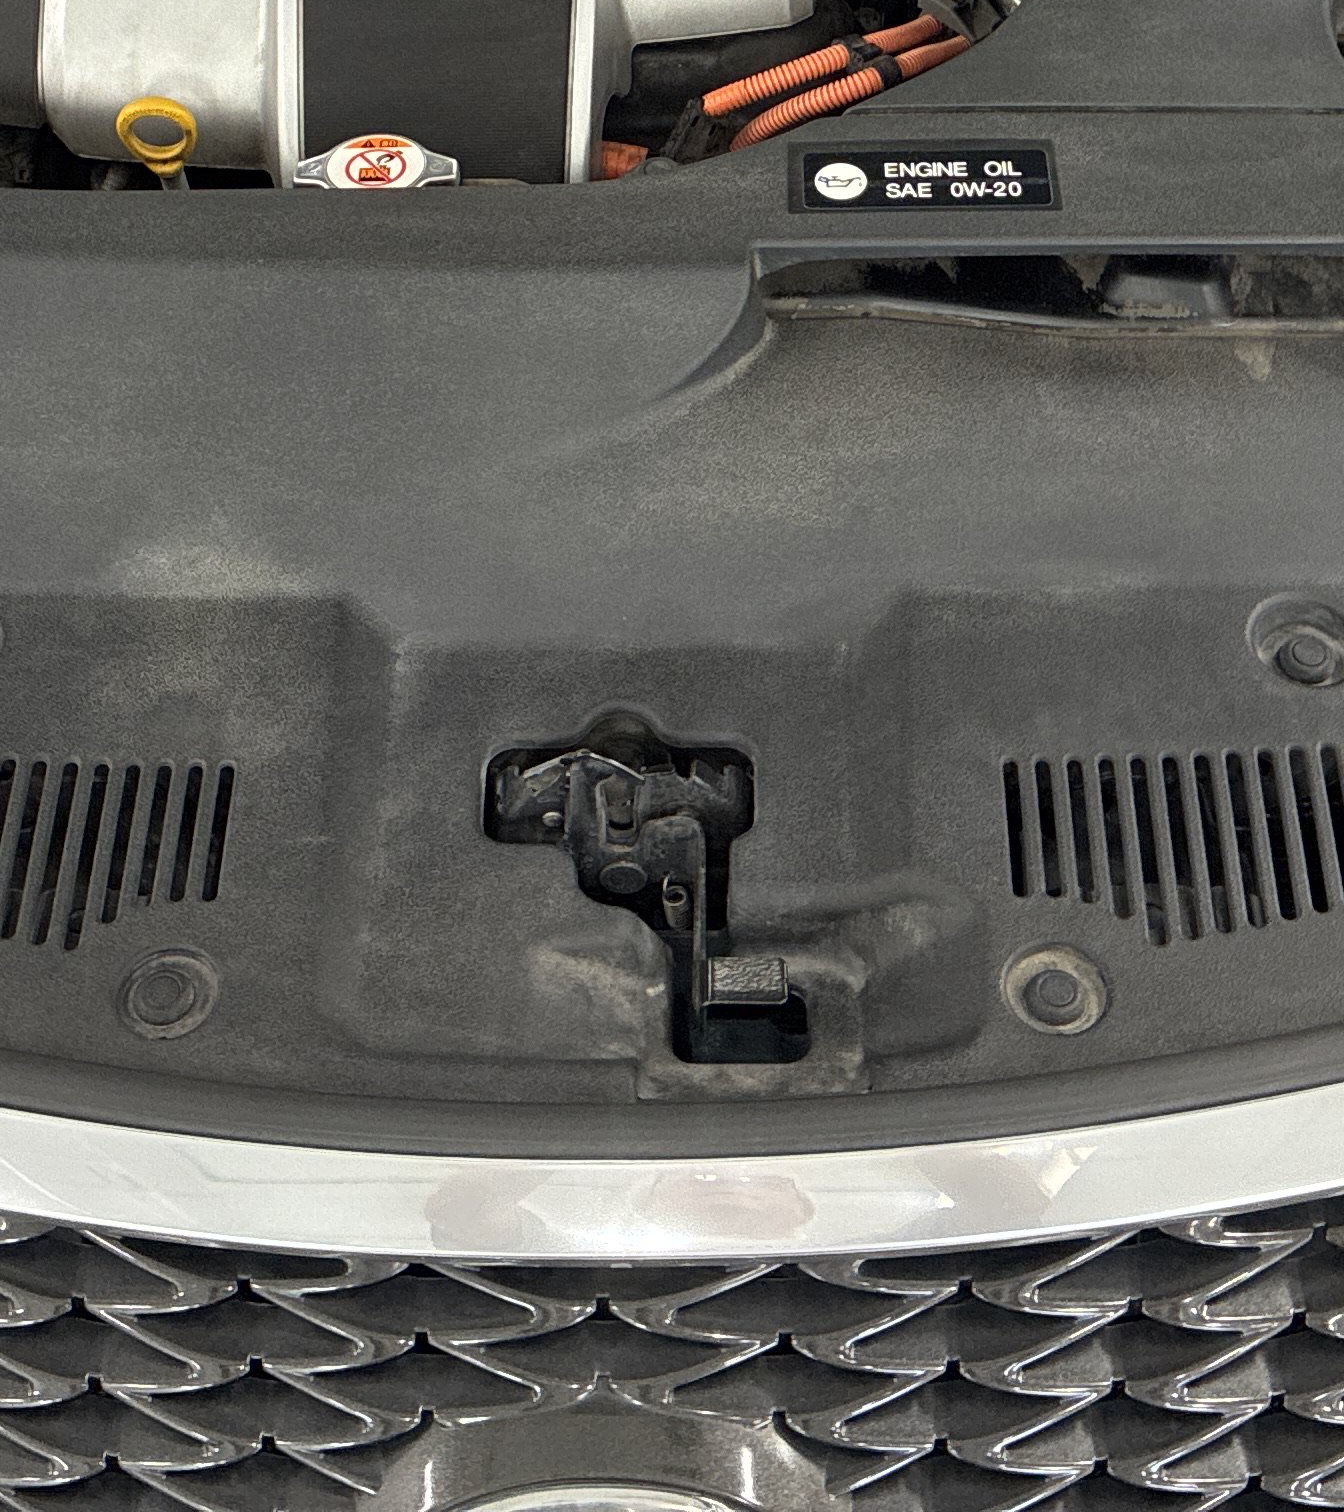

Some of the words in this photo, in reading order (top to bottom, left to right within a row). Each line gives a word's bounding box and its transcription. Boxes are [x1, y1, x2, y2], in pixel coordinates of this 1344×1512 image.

[884, 162, 968, 178] ENGINE
[983, 161, 1023, 177] OIL
[885, 182, 933, 199] SAE
[950, 181, 1023, 198] 0W-20
